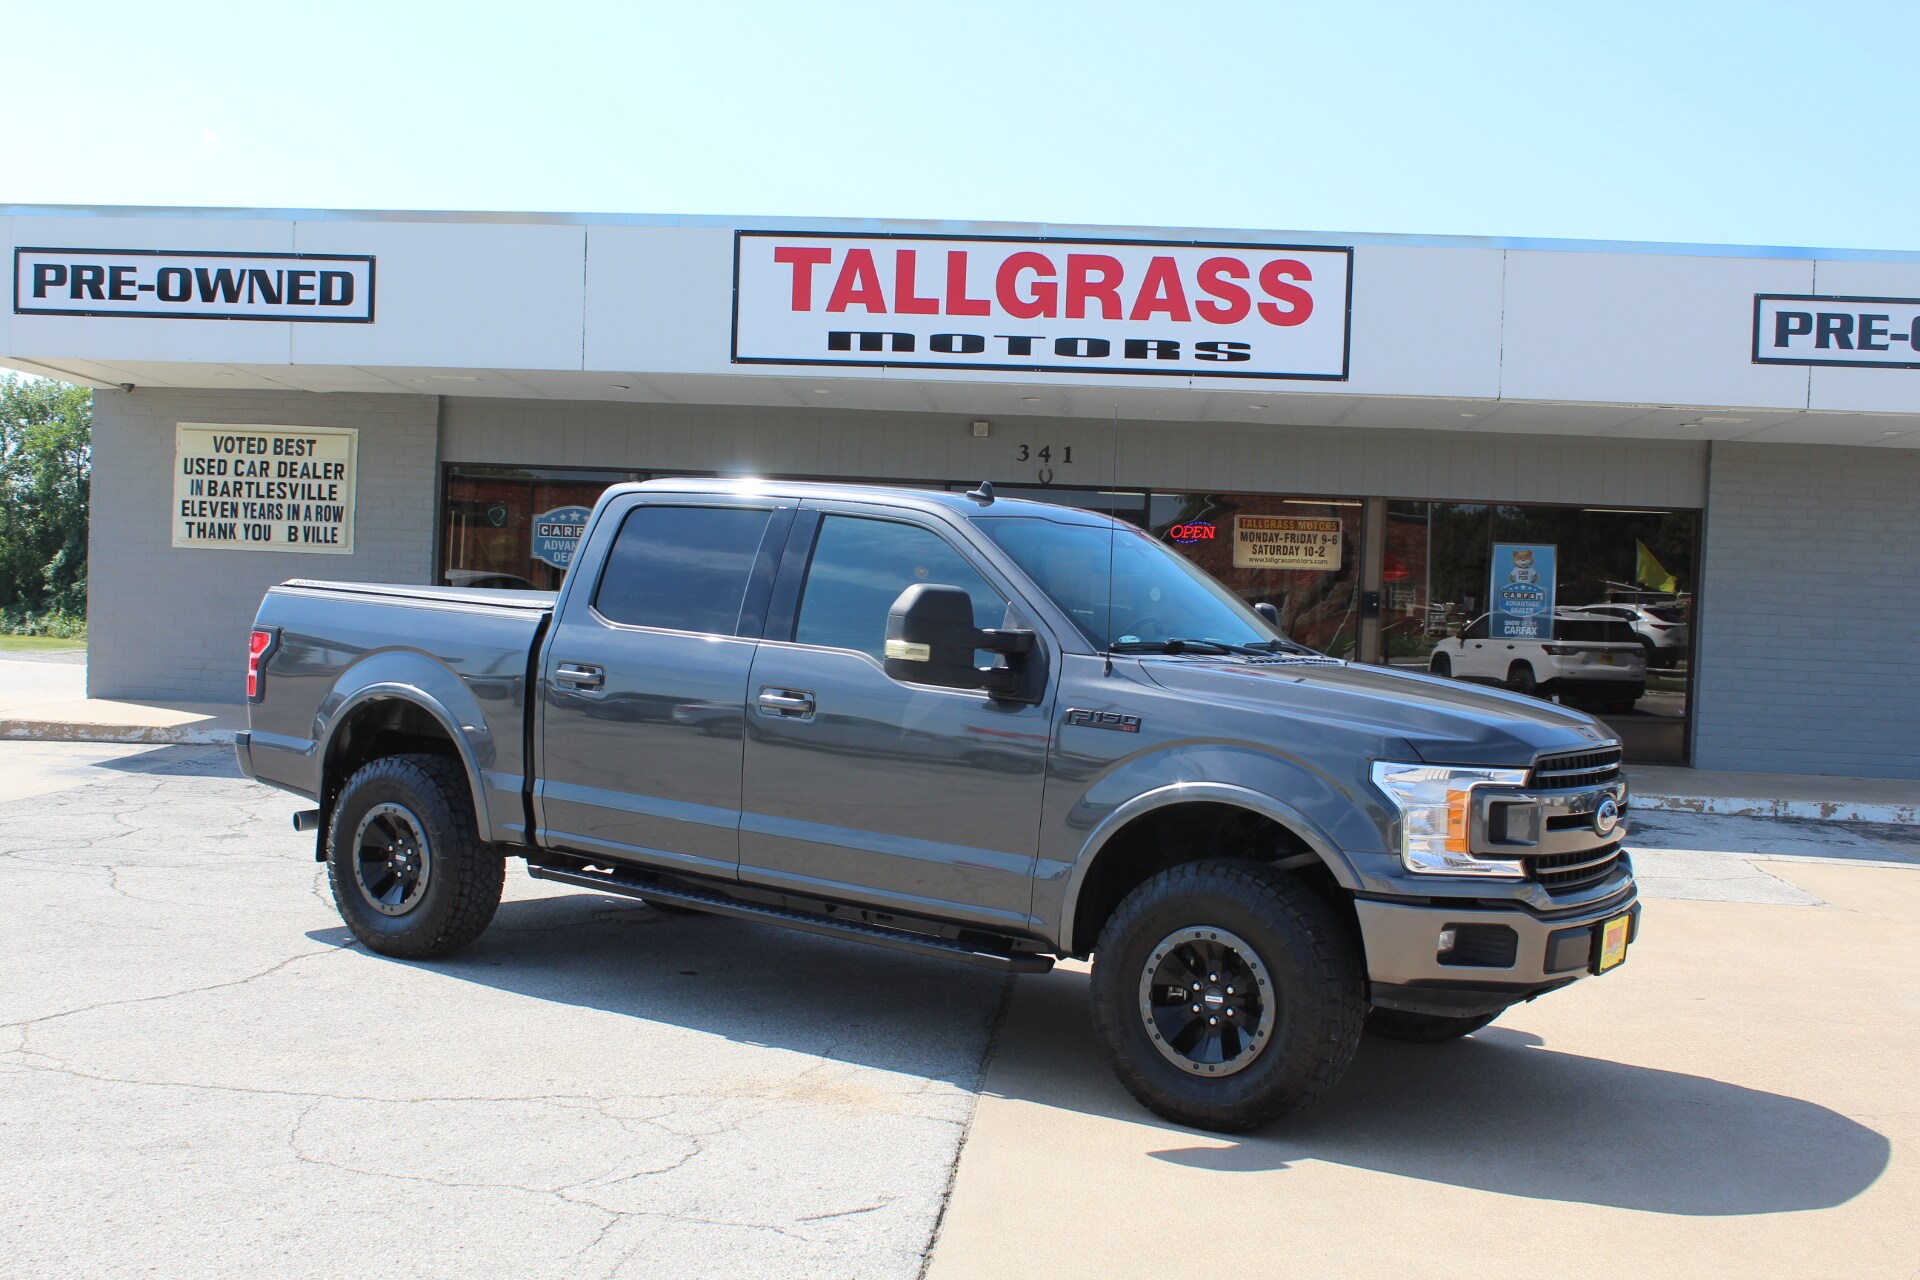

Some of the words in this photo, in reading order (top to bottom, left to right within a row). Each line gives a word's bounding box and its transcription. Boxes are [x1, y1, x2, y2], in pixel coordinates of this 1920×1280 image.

[33, 263, 354, 307] PRE-OWNED
[774, 246, 1314, 327] TALLGRASS
[1774, 311, 1920, 352] PRE-
[828, 331, 1251, 362] MOTORS
[213, 435, 268, 455] VOTED
[273, 438, 317, 457] BEST
[1016, 444, 1073, 464] 341
[183, 457, 228, 476] USED
[234, 459, 270, 478] CAR
[277, 461, 345, 480] DEALER
[190, 479, 204, 496] IN
[207, 480, 338, 501] BARTLESVILLE
[181, 500, 239, 519] ELEVEN
[242, 502, 283, 521] YEARS
[287, 503, 300, 521] IN
[303, 504, 312, 522] A
[315, 504, 344, 523] ROW
[185, 521, 237, 540] THANK
[243, 523, 272, 542] YOU
[1170, 525, 1216, 539] OPEN
[1241, 519, 1295, 529] TALLGRASS
[1298, 520, 1338, 531] MOTORS
[1321, 534, 1338, 545] 9-6
[1248, 556, 1328, 565] www.tallgrassmotors.com
[1252, 544, 1300, 556] SATURDAY
[1303, 546, 1325, 557] 10-2
[1504, 626, 1538, 635] CARFAX
